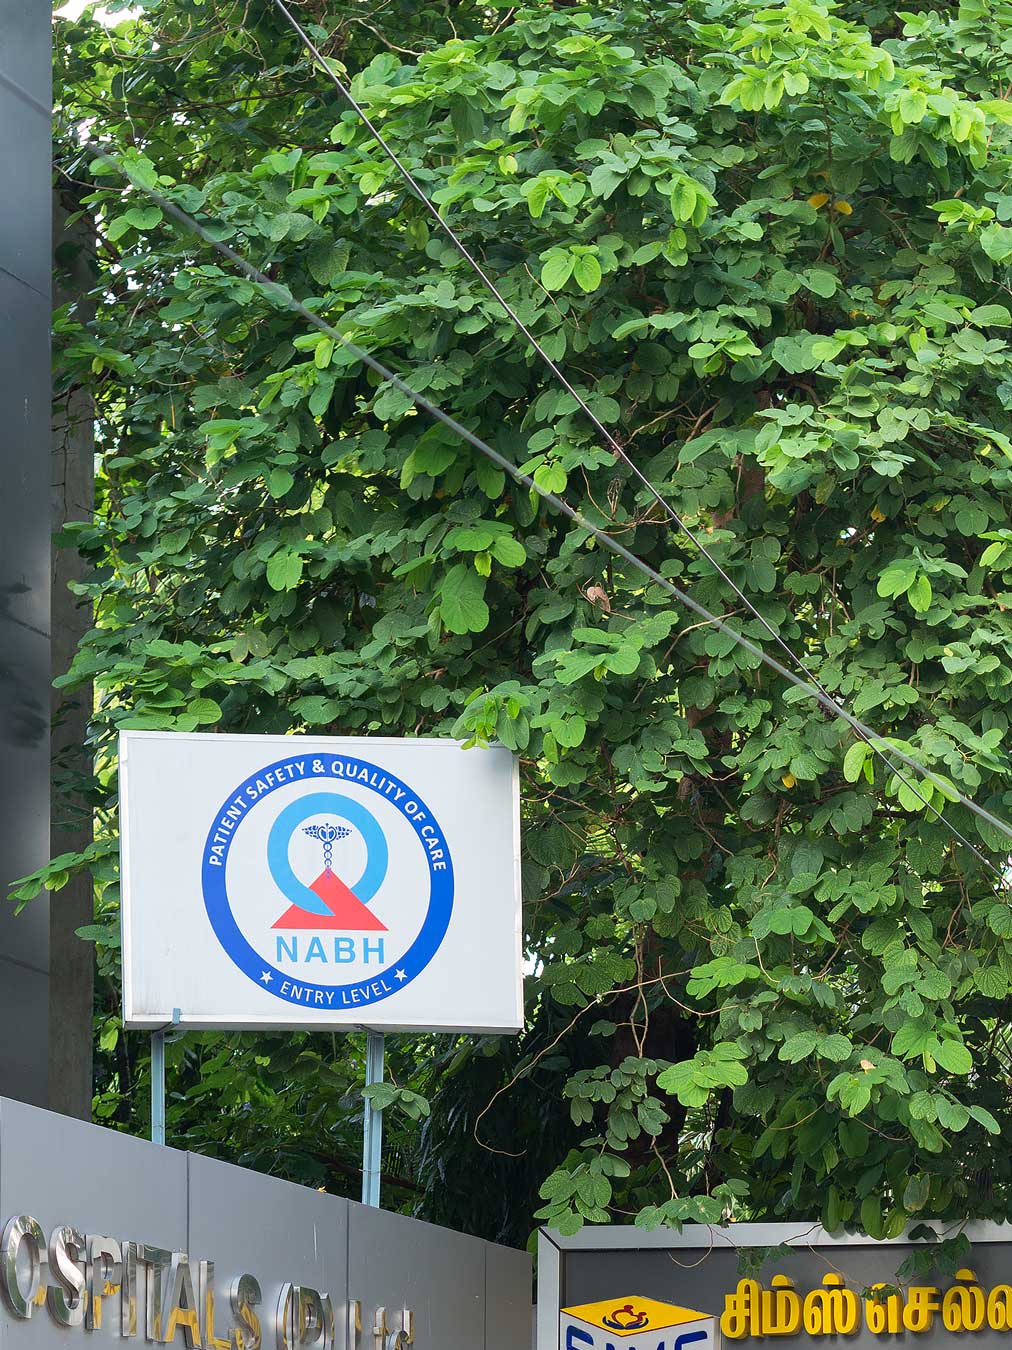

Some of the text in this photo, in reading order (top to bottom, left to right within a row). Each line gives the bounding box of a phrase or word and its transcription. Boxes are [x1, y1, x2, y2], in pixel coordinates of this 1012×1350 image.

[208, 759, 448, 872] PATIENT SAFETY & QUALITY OF CARE
[277, 936, 384, 964] NABH
[279, 979, 393, 1005] ENTRY LEVEL
[721, 1274, 860, 1339] சிம்ஸ்
